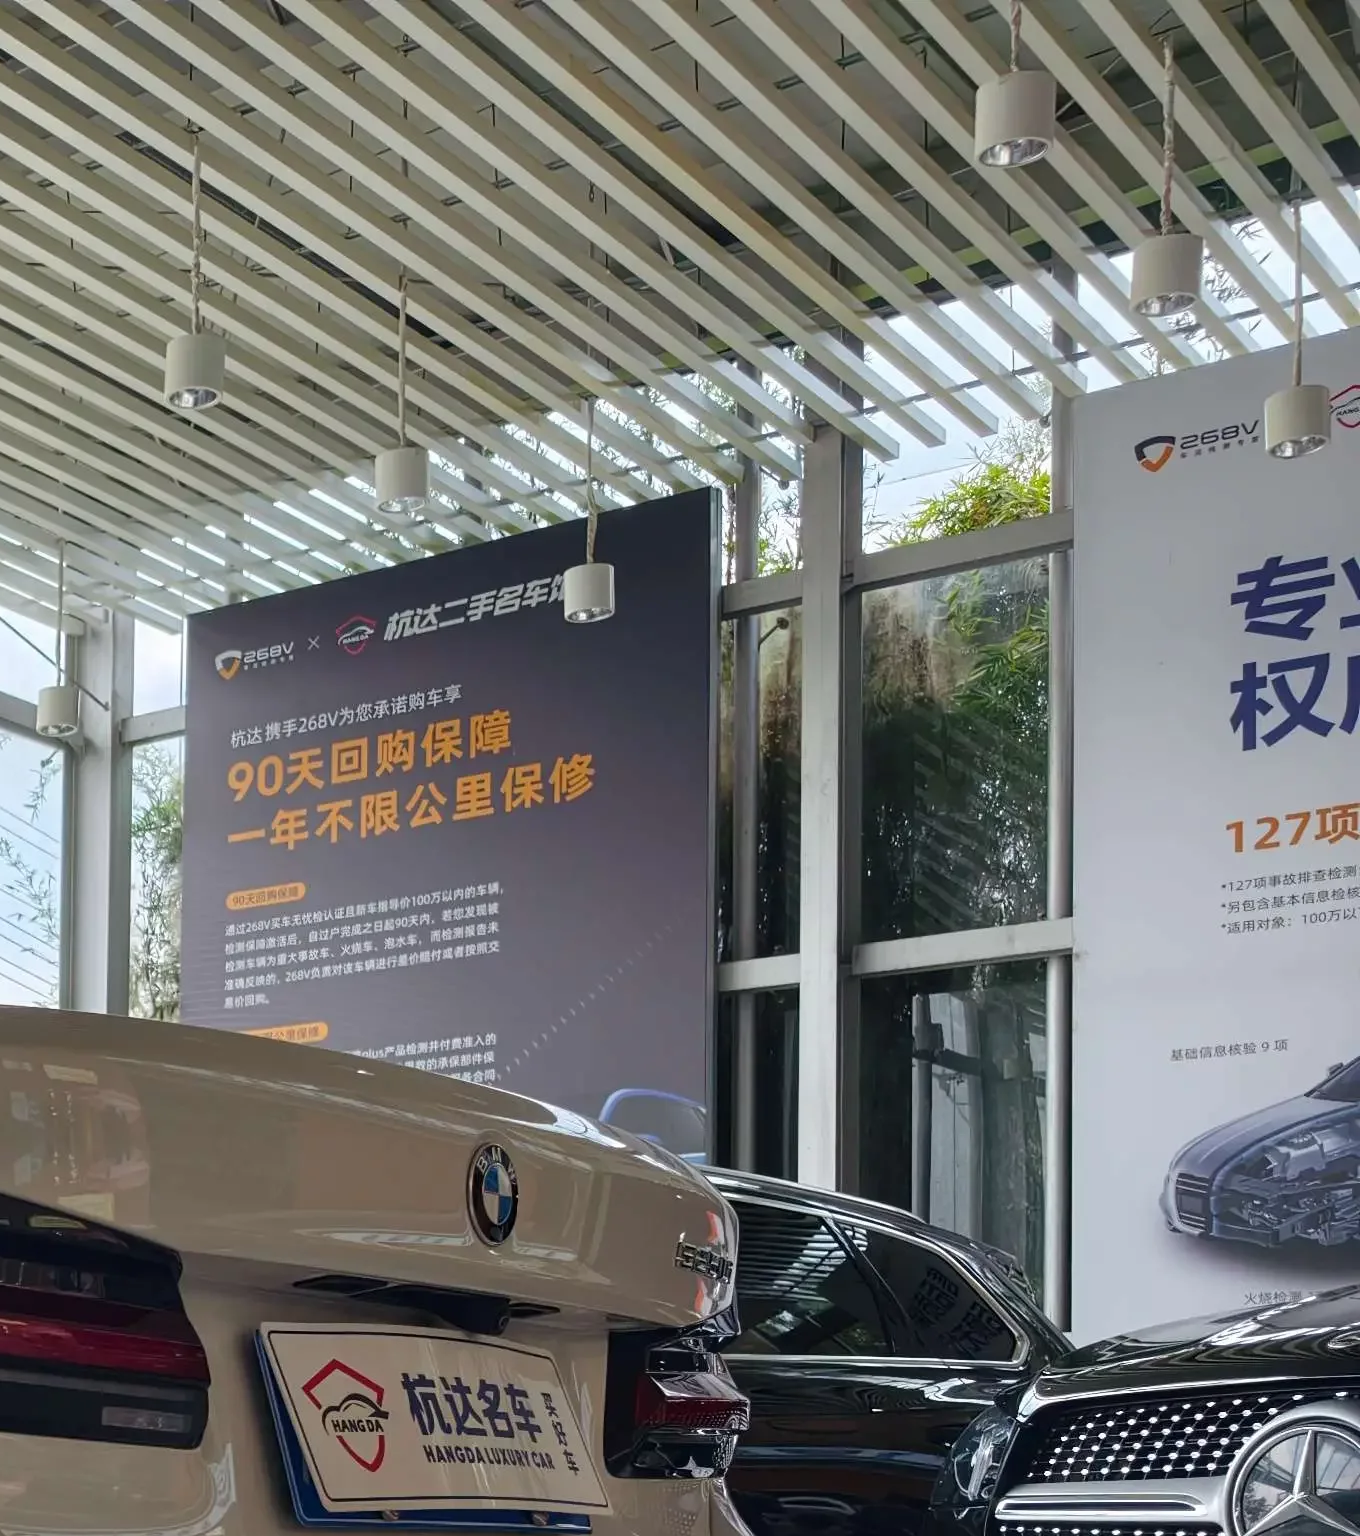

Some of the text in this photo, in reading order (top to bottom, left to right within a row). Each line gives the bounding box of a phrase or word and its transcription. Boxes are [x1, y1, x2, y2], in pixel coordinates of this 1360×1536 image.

[1180, 419, 1260, 450] 268V
[1230, 555, 1360, 641] 专
[243, 641, 295, 664] 268V
[231, 684, 463, 750] 杭达 携手268V为您承诺购车享
[1230, 653, 1360, 751] 权
[227, 709, 512, 802] 90天回购保障
[227, 753, 595, 851] 一年不限公里保修
[1226, 802, 1360, 853] 127项
[1301, 907, 1360, 925] 100万以
[1261, 1041, 1270, 1053] 9
[1273, 1039, 1289, 1052] 项
[331, 1418, 384, 1433] HANG DA
[400, 1372, 543, 1444] 杭达名车
[422, 1445, 555, 1471] HANGDA LUXURY CAR
